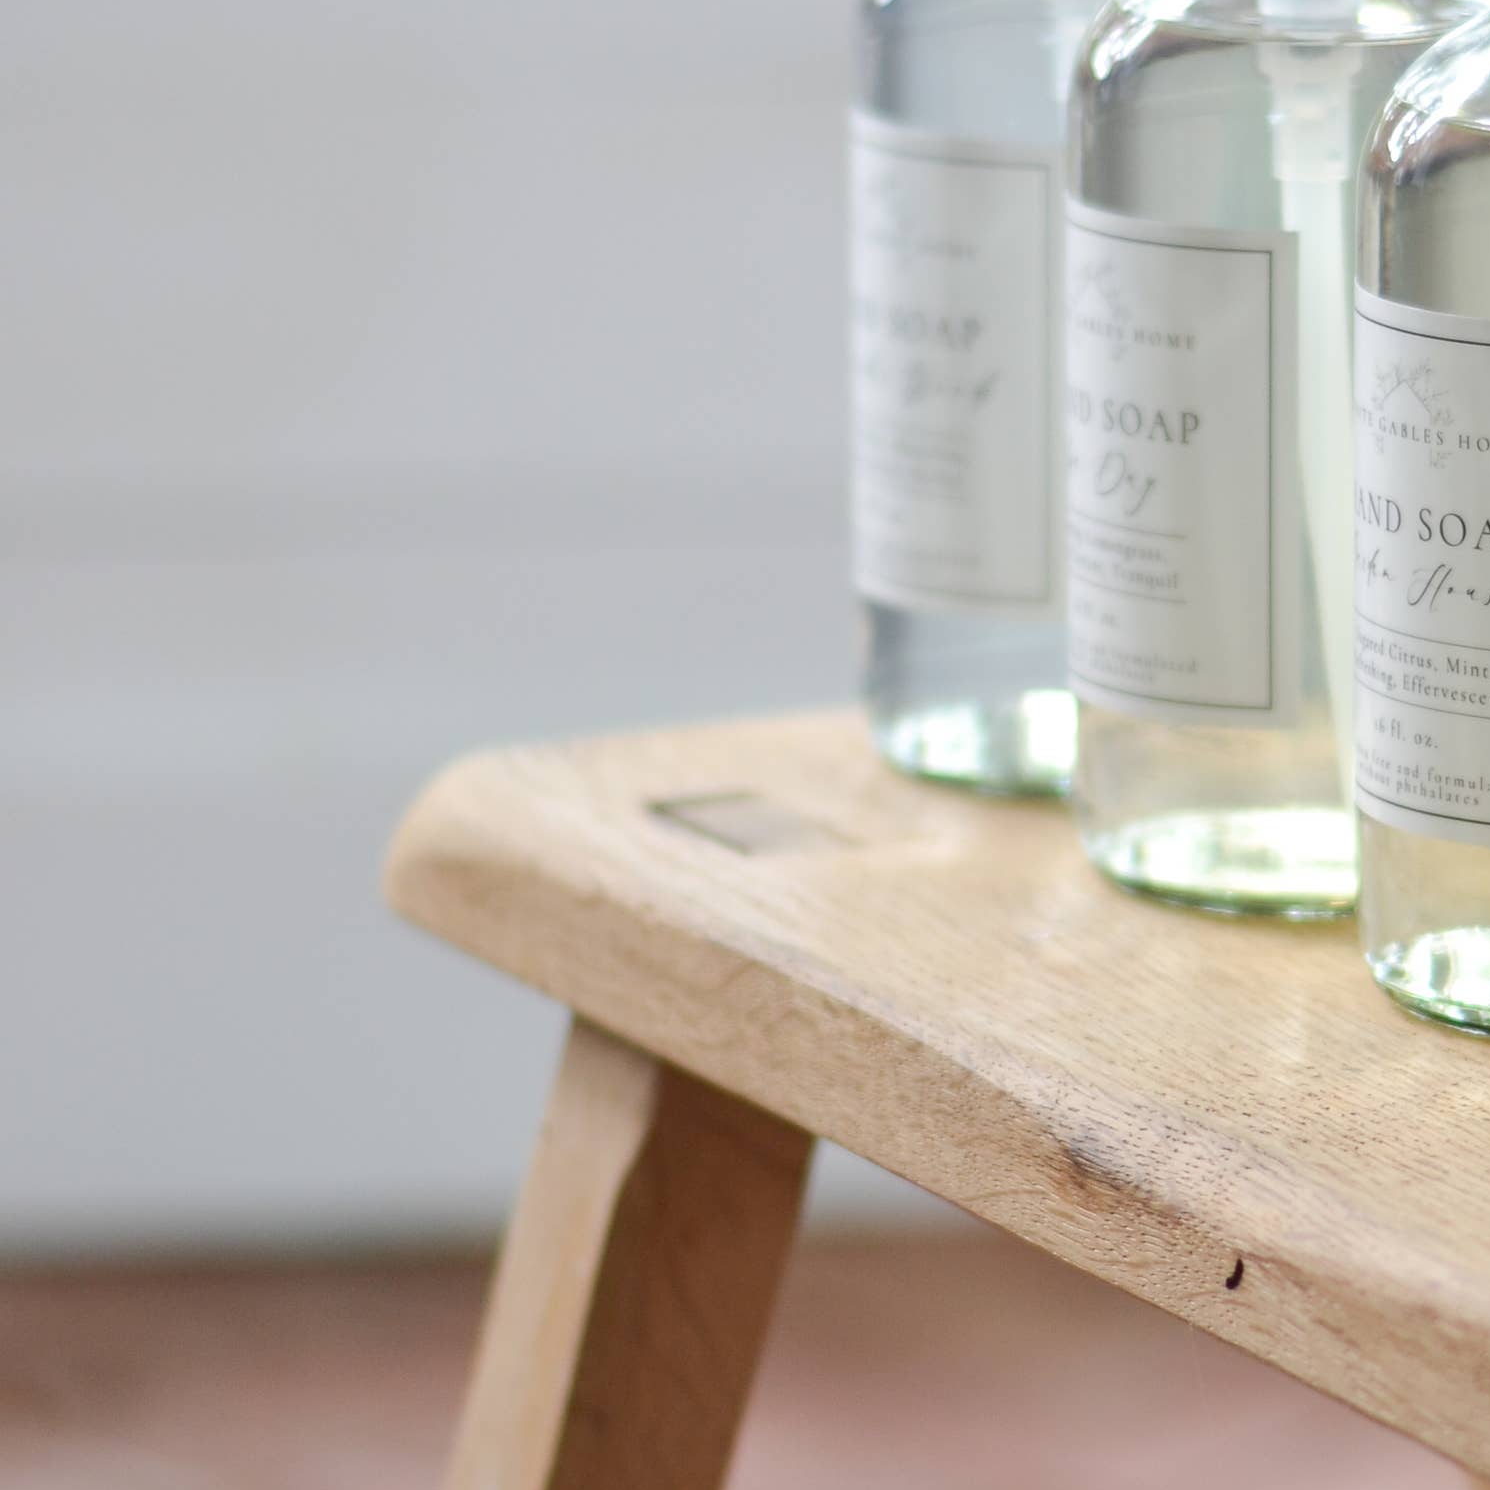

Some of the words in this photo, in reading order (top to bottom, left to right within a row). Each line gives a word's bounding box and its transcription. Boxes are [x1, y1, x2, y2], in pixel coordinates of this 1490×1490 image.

[1102, 398, 1201, 446] SOAP
[1378, 416, 1445, 446] GABLES
[1356, 485, 1403, 534] AND
[1413, 732, 1440, 750] oz.
[1395, 775, 1480, 807] phthalates
